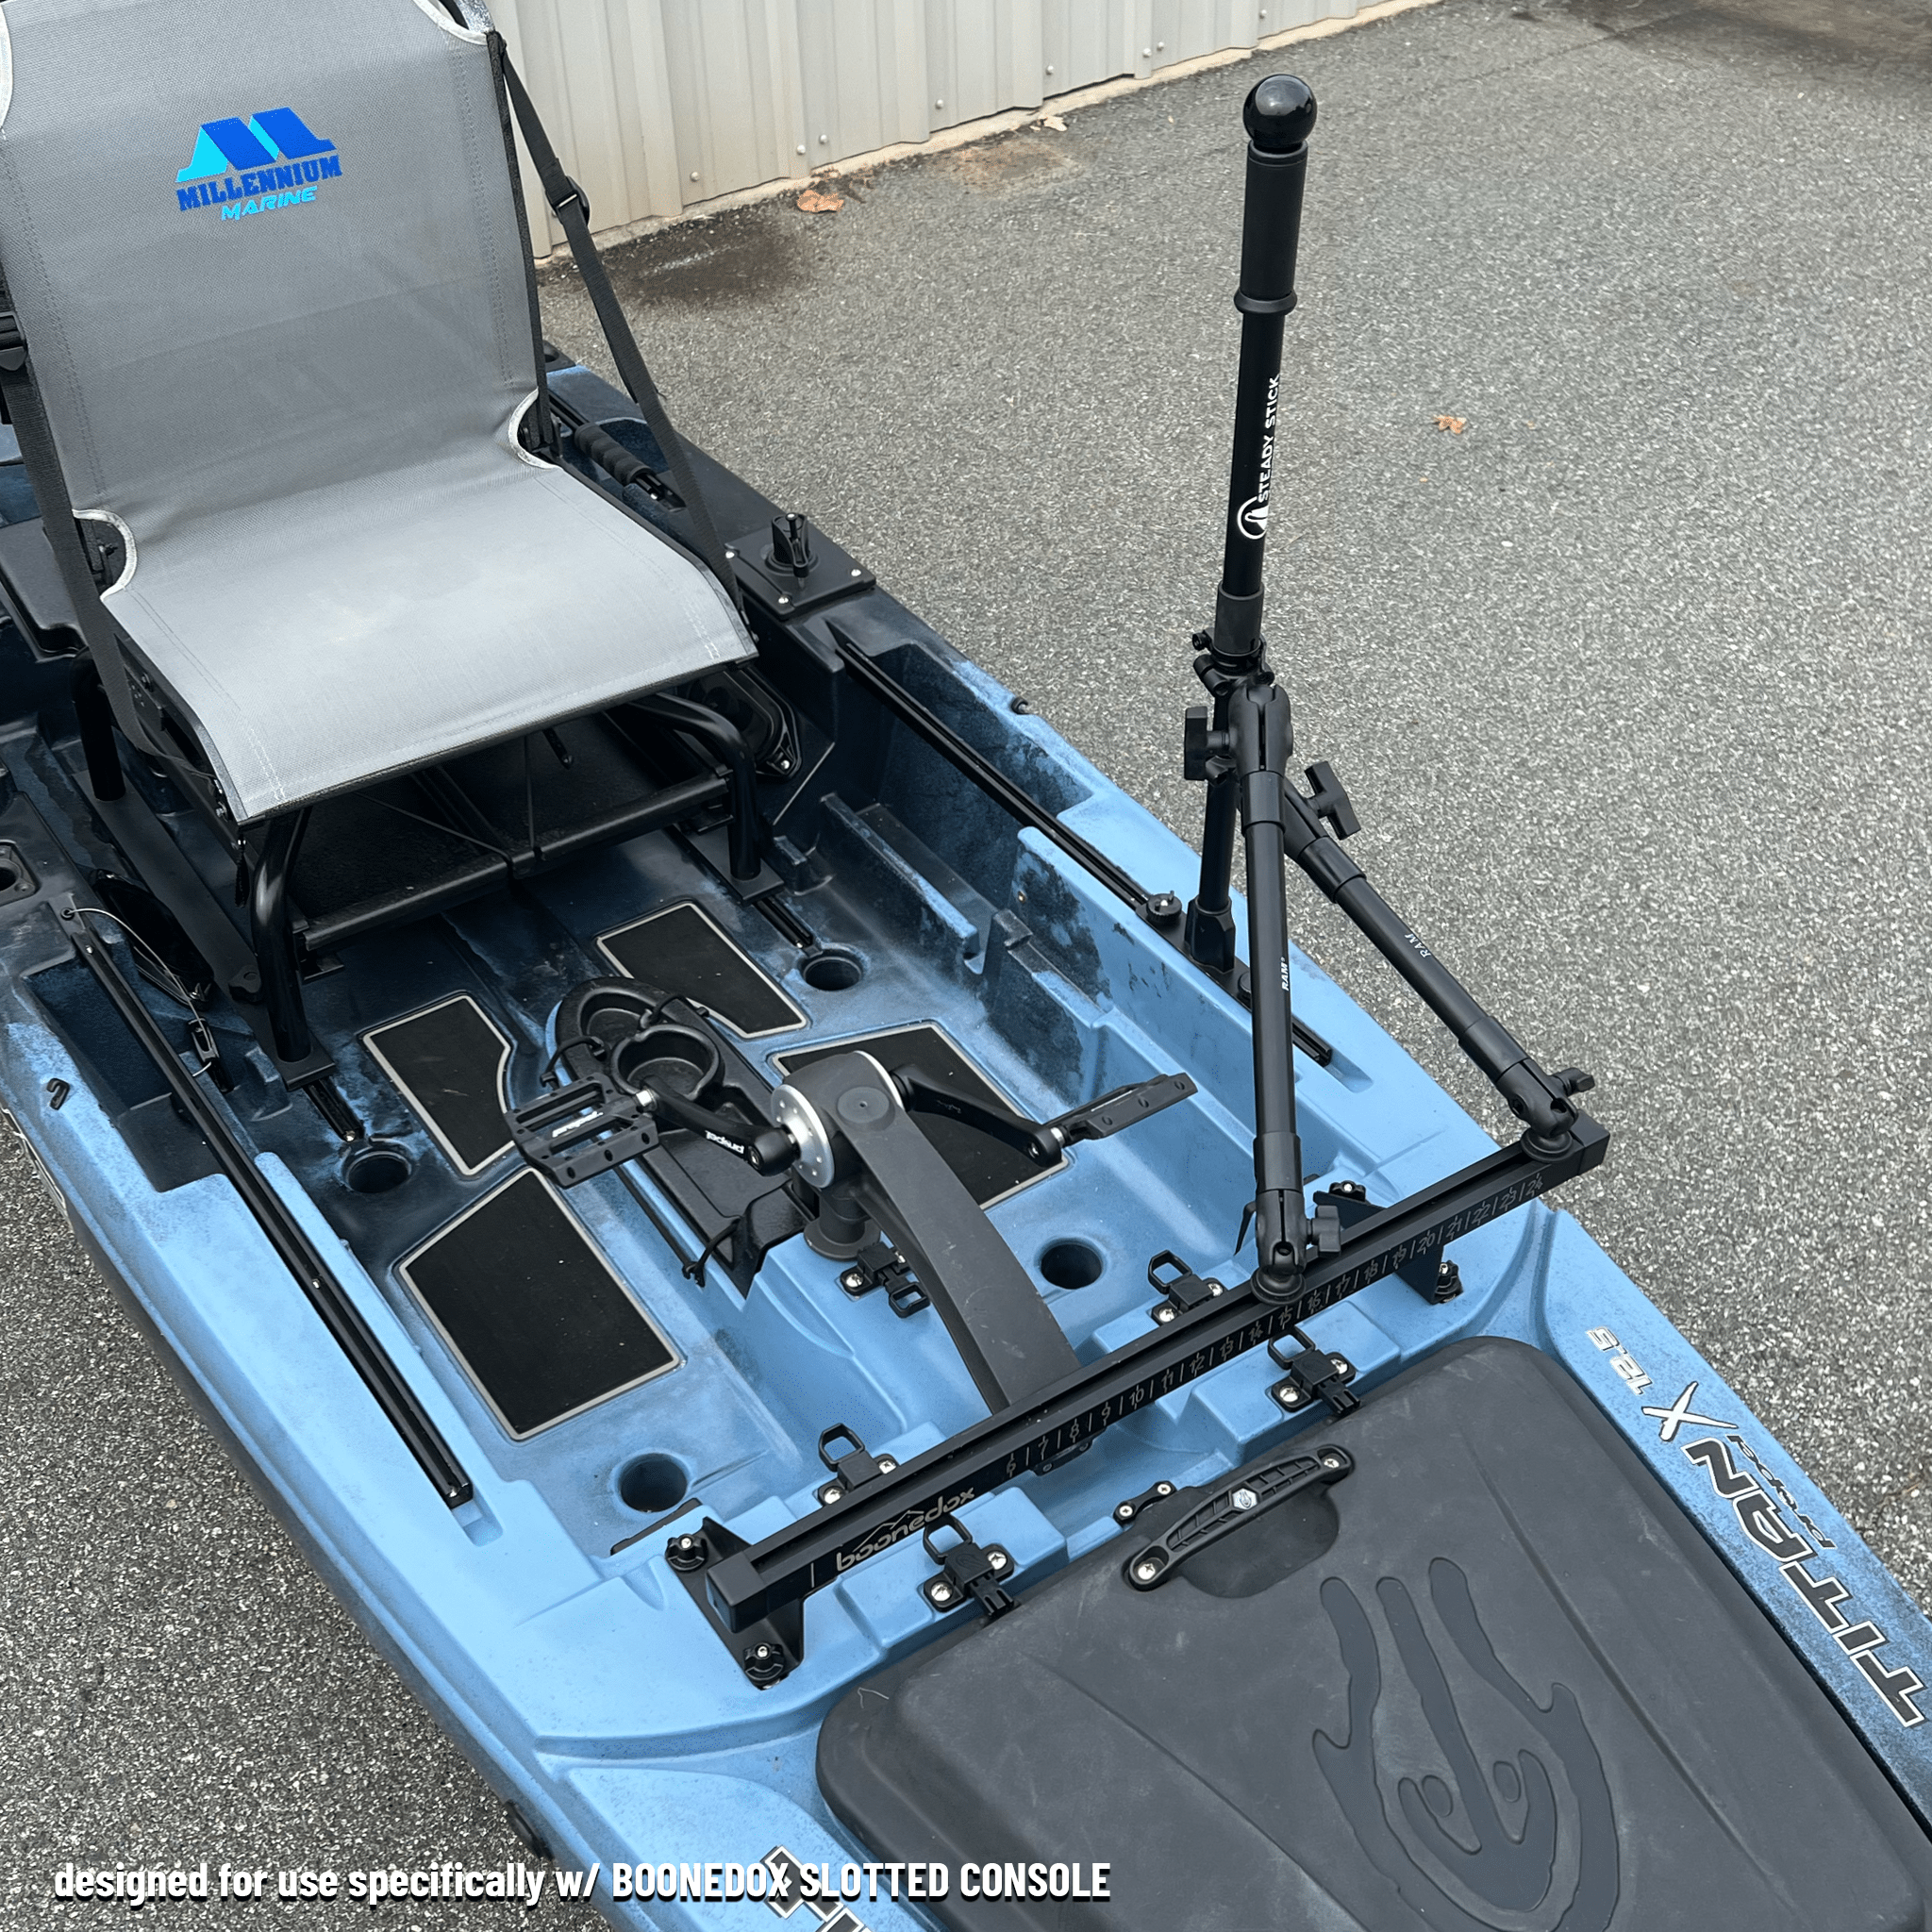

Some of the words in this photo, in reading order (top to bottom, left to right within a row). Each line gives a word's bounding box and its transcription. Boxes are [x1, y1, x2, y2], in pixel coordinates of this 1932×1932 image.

[176, 155, 342, 211] MILLENNIUM
[222, 186, 317, 221] MARINE
[1258, 435, 1274, 503] STEADY
[1266, 374, 1280, 429] STICK
[1405, 933, 1432, 958] RAM
[1039, 1437, 1049, 1457] 7
[1070, 1422, 1079, 1440] 8
[1102, 1405, 1110, 1424] 9
[1130, 1387, 1144, 1406] 10
[1190, 1355, 1205, 1372] 12
[1278, 1307, 1292, 1325] 15
[1336, 1276, 1351, 1295] 17
[1417, 1233, 1435, 1253] 20
[1472, 1203, 1491, 1223] 22
[1499, 1189, 1516, 1208] 23
[1585, 1324, 1653, 1396] 12.5
[1641, 1380, 1740, 1442] X
[836, 1487, 975, 1572] boonedox
[1725, 1433, 1837, 1550] propel
[1681, 1436, 1926, 1728] TITAN
